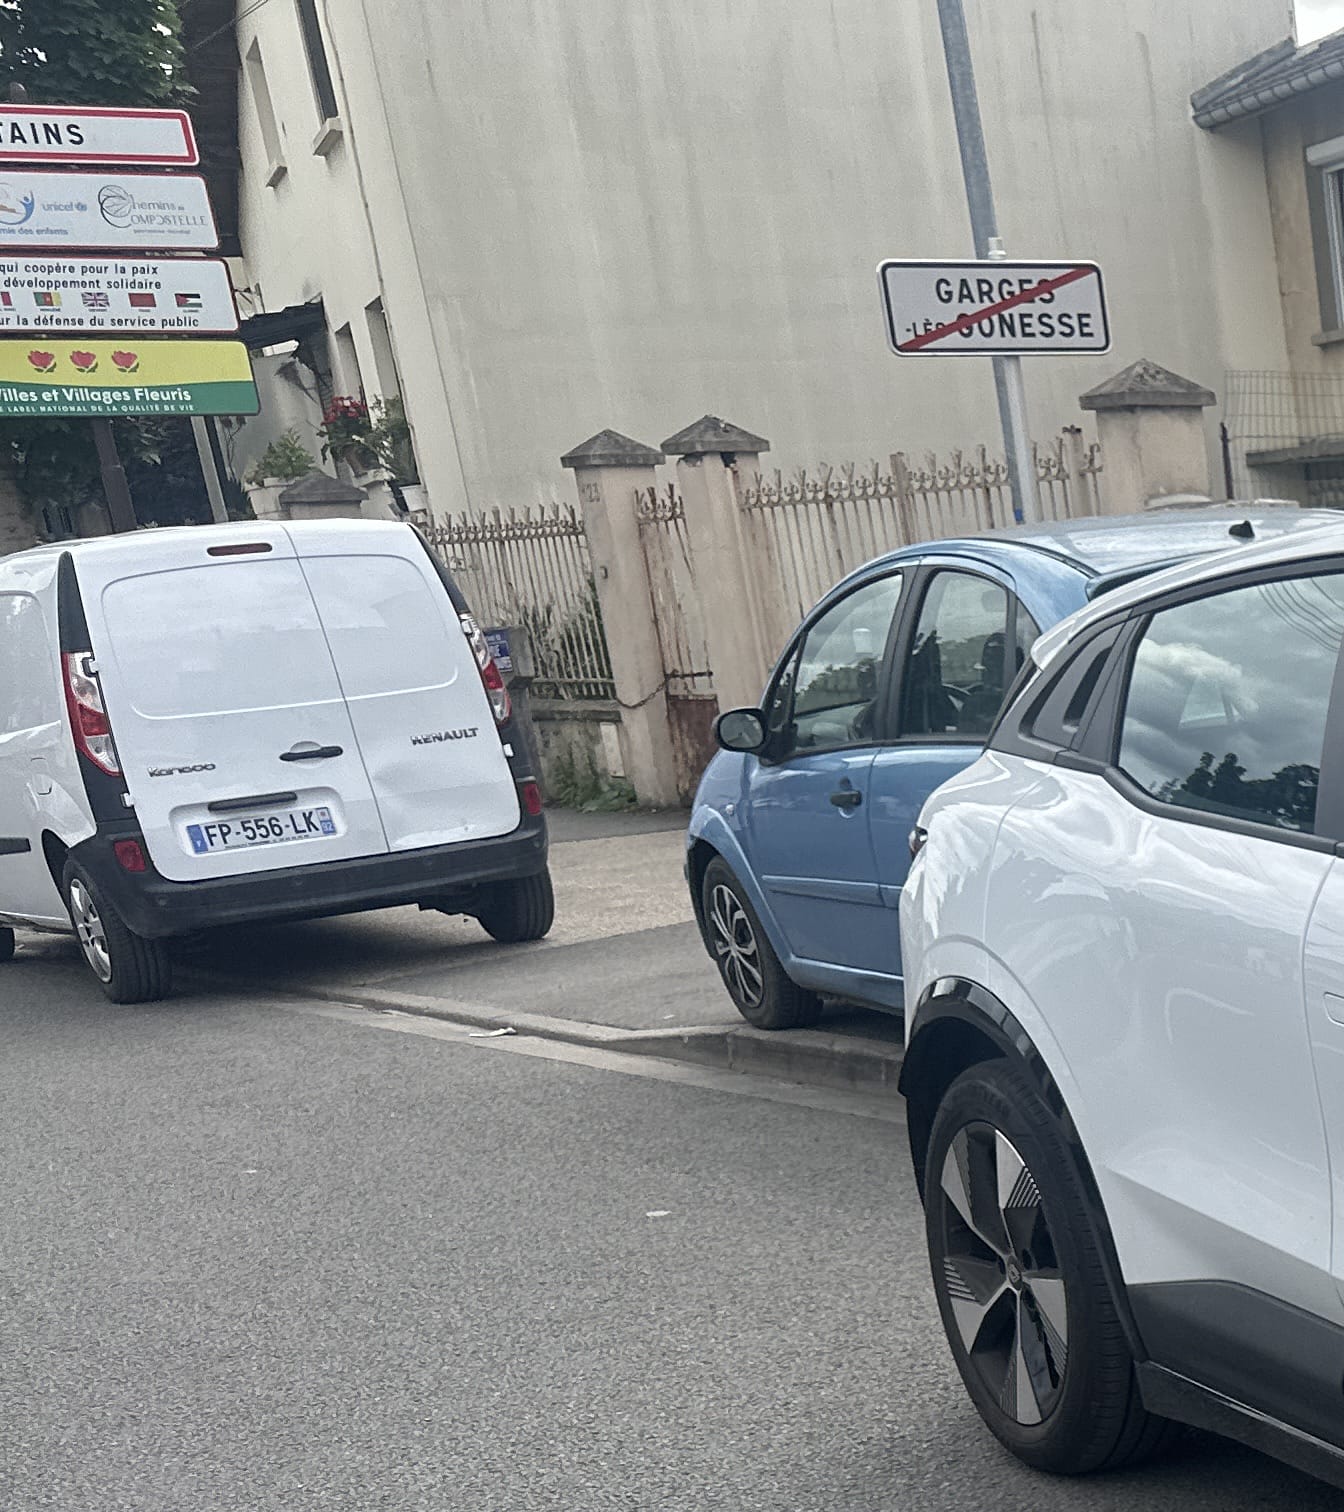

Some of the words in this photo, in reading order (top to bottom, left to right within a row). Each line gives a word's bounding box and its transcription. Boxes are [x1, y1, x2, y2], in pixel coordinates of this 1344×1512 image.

[0, 121, 84, 146] AINS
[18, 227, 33, 236] des
[0, 261, 18, 275] qui
[24, 262, 76, 276] coopère
[81, 265, 109, 276] pour
[114, 263, 126, 275] la
[132, 264, 158, 277] paix
[3, 276, 101, 291] développement
[106, 278, 161, 290] solidaire
[935, 278, 1055, 304] GARGES
[17, 314, 29, 326] la
[34, 314, 84, 326] défense
[89, 315, 105, 327] du
[111, 315, 156, 327] service
[161, 315, 199, 329] public
[0, 388, 38, 402] illes
[42, 389, 59, 402] et
[62, 388, 131, 405] Villages
[134, 387, 191, 401] Fleuris
[40, 404, 87, 412] NATIONAL
[410, 727, 478, 746] RENAULT
[204, 811, 320, 847] FP-556-LK
